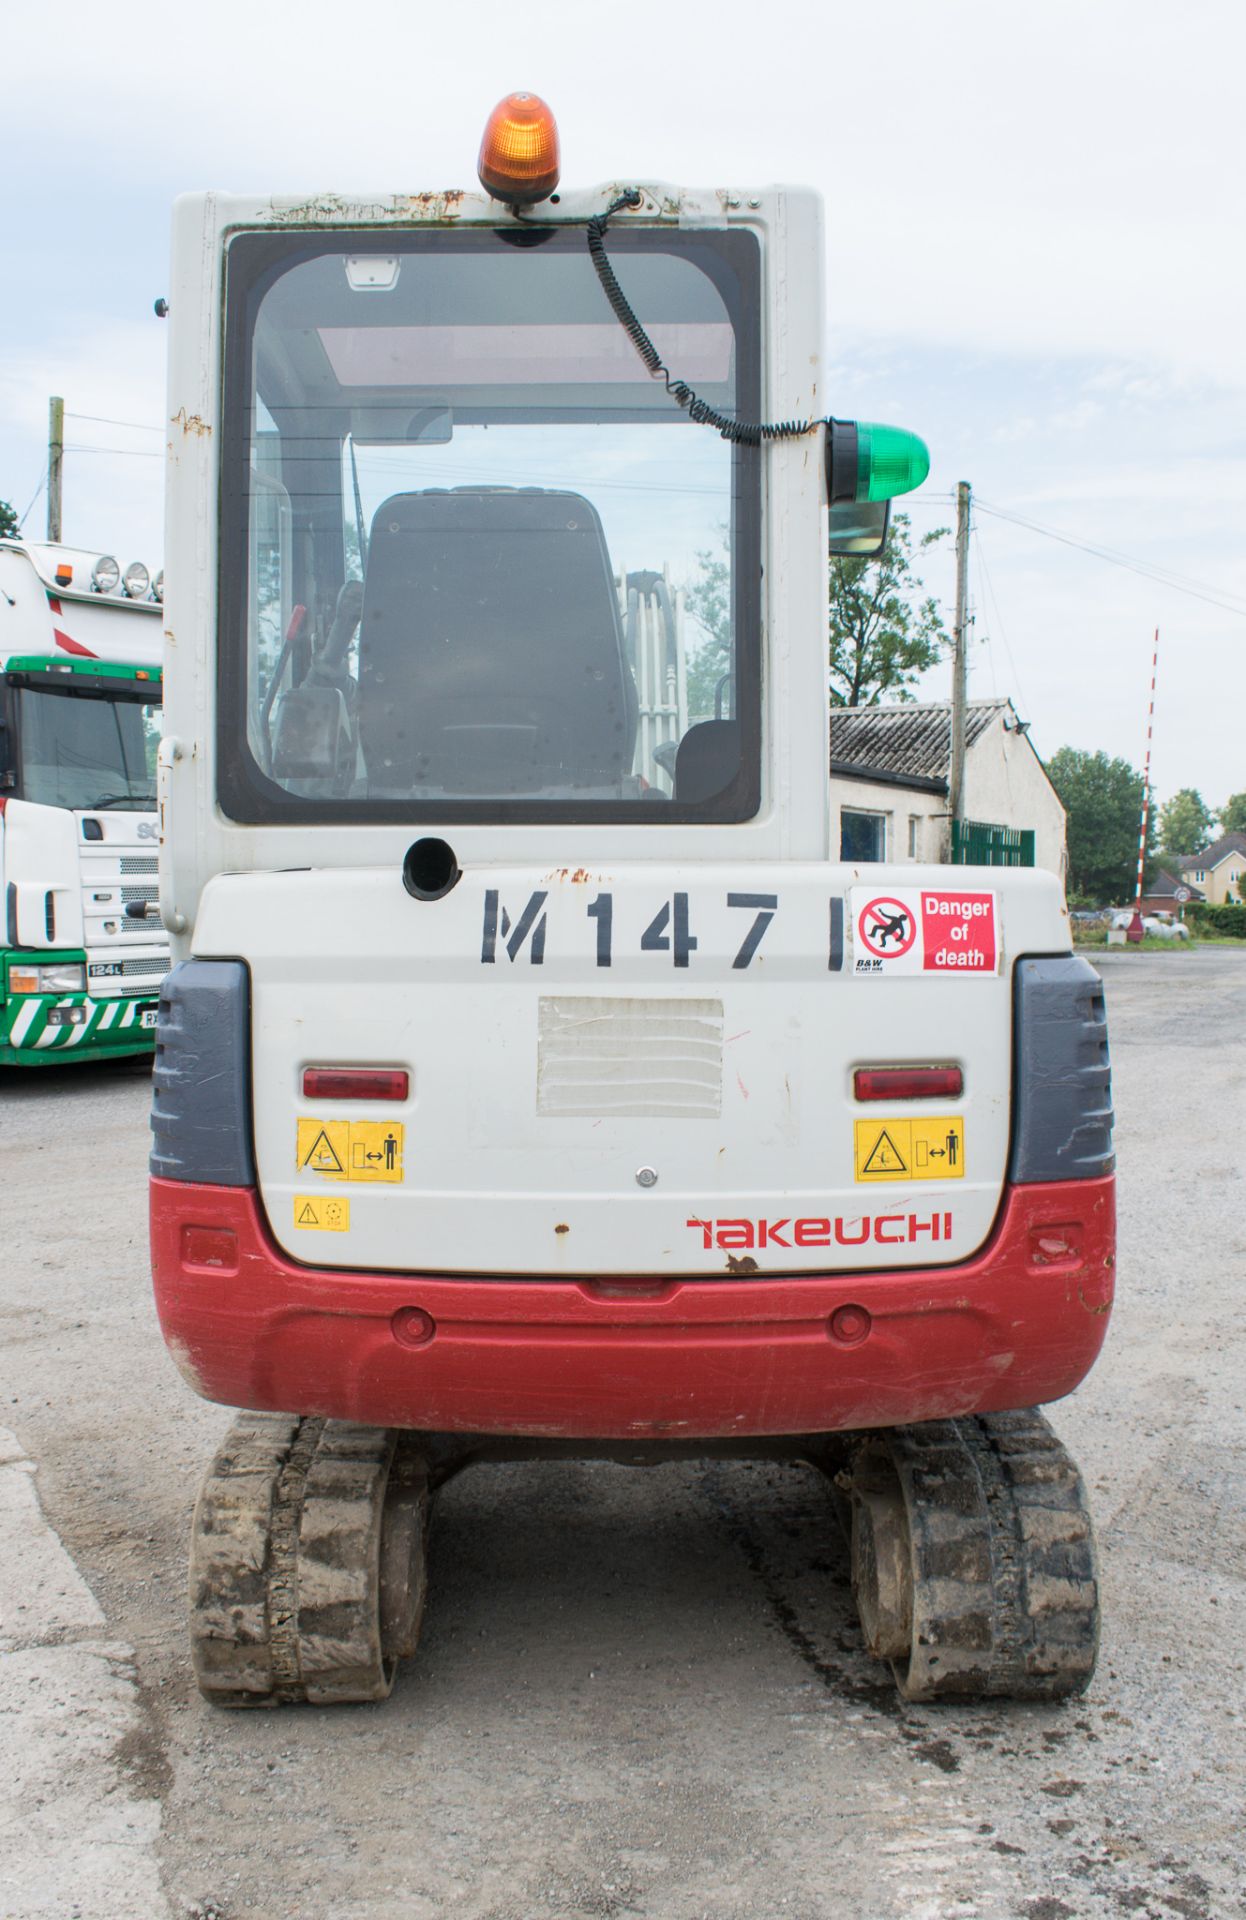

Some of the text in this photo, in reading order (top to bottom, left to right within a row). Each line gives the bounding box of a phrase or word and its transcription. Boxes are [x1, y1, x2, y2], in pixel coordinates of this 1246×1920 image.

[925, 896, 990, 920] Danger
[950, 923, 968, 941] of
[856, 959, 883, 967] B&W
[935, 947, 984, 966] death
